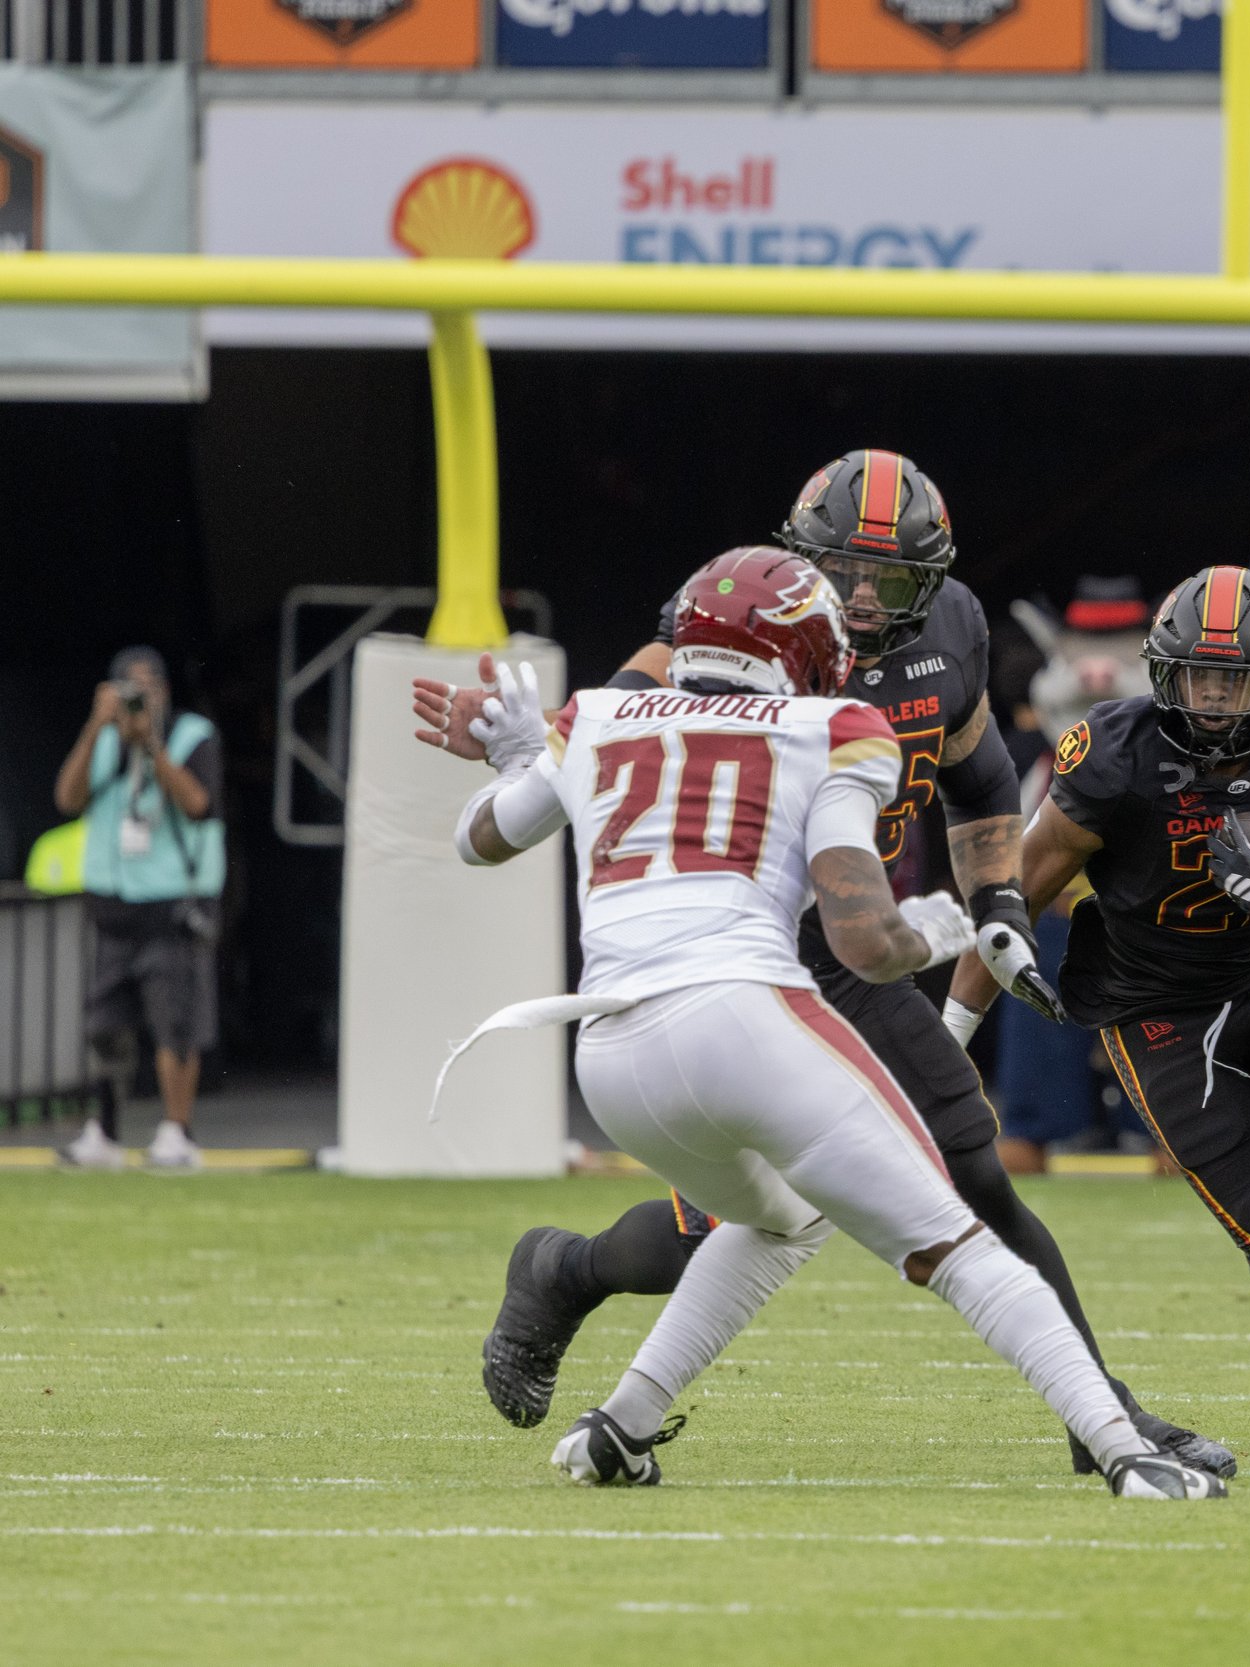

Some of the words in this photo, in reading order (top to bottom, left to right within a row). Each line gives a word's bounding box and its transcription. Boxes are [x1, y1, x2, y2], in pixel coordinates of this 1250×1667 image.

[620, 156, 776, 213] Shell
[690, 650, 744, 665] STALLIONS
[905, 656, 947, 680] NOBULL
[865, 671, 883, 684] UFL
[614, 692, 790, 725] CROWDER
[1229, 782, 1250, 793] UFL
[587, 728, 778, 893] 20
